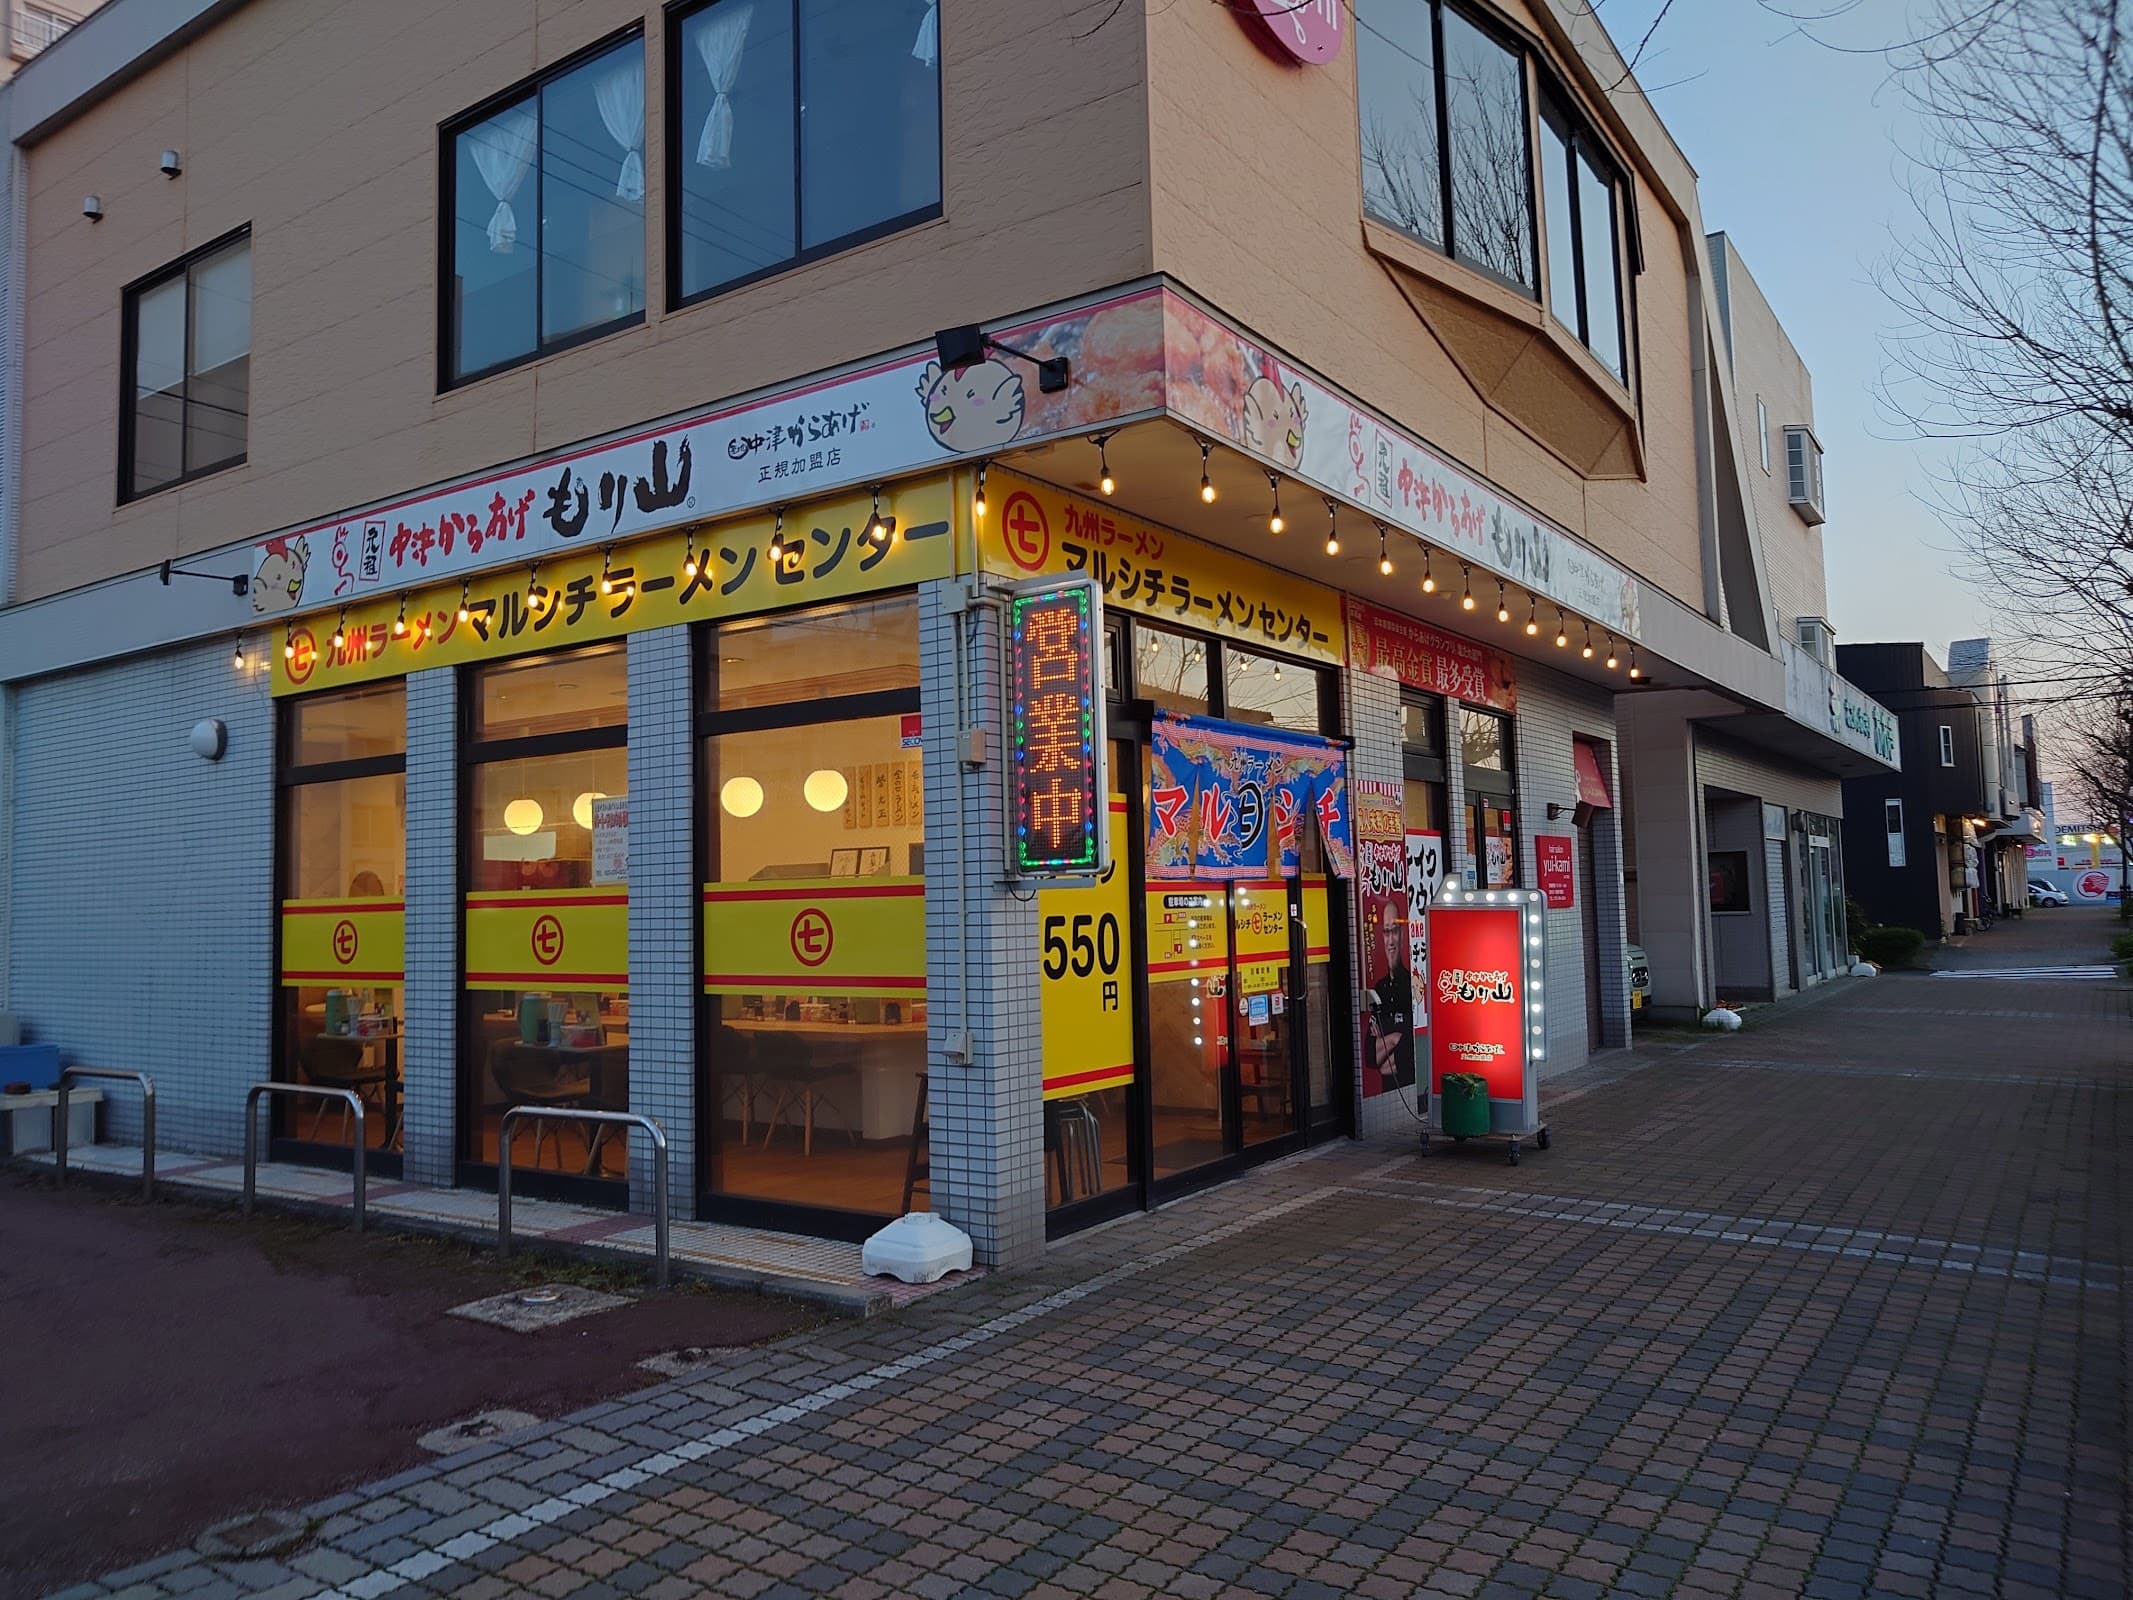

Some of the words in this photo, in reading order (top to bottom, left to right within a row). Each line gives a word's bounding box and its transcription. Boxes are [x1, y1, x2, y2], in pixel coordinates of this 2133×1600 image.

[543, 434, 692, 538] もり山
[757, 447, 842, 484] 正規加盟店
[363, 526, 380, 576] 元祖
[1064, 504, 1164, 560] 九州ラーメン
[326, 610, 459, 668] 九州ラーメン
[1375, 636, 1433, 686] 最高金賞
[1436, 655, 1486, 702] 最多受賞
[1026, 608, 1082, 848] 営業中
[1543, 855, 1570, 877] yui-kami
[1263, 911, 1283, 921] ラーメン
[1264, 924, 1284, 934] センター
[1411, 920, 1425, 938] ake
[1043, 912, 1120, 980] 550
[1103, 980, 1118, 1012] 円
[1457, 983, 1511, 1002] もり山
